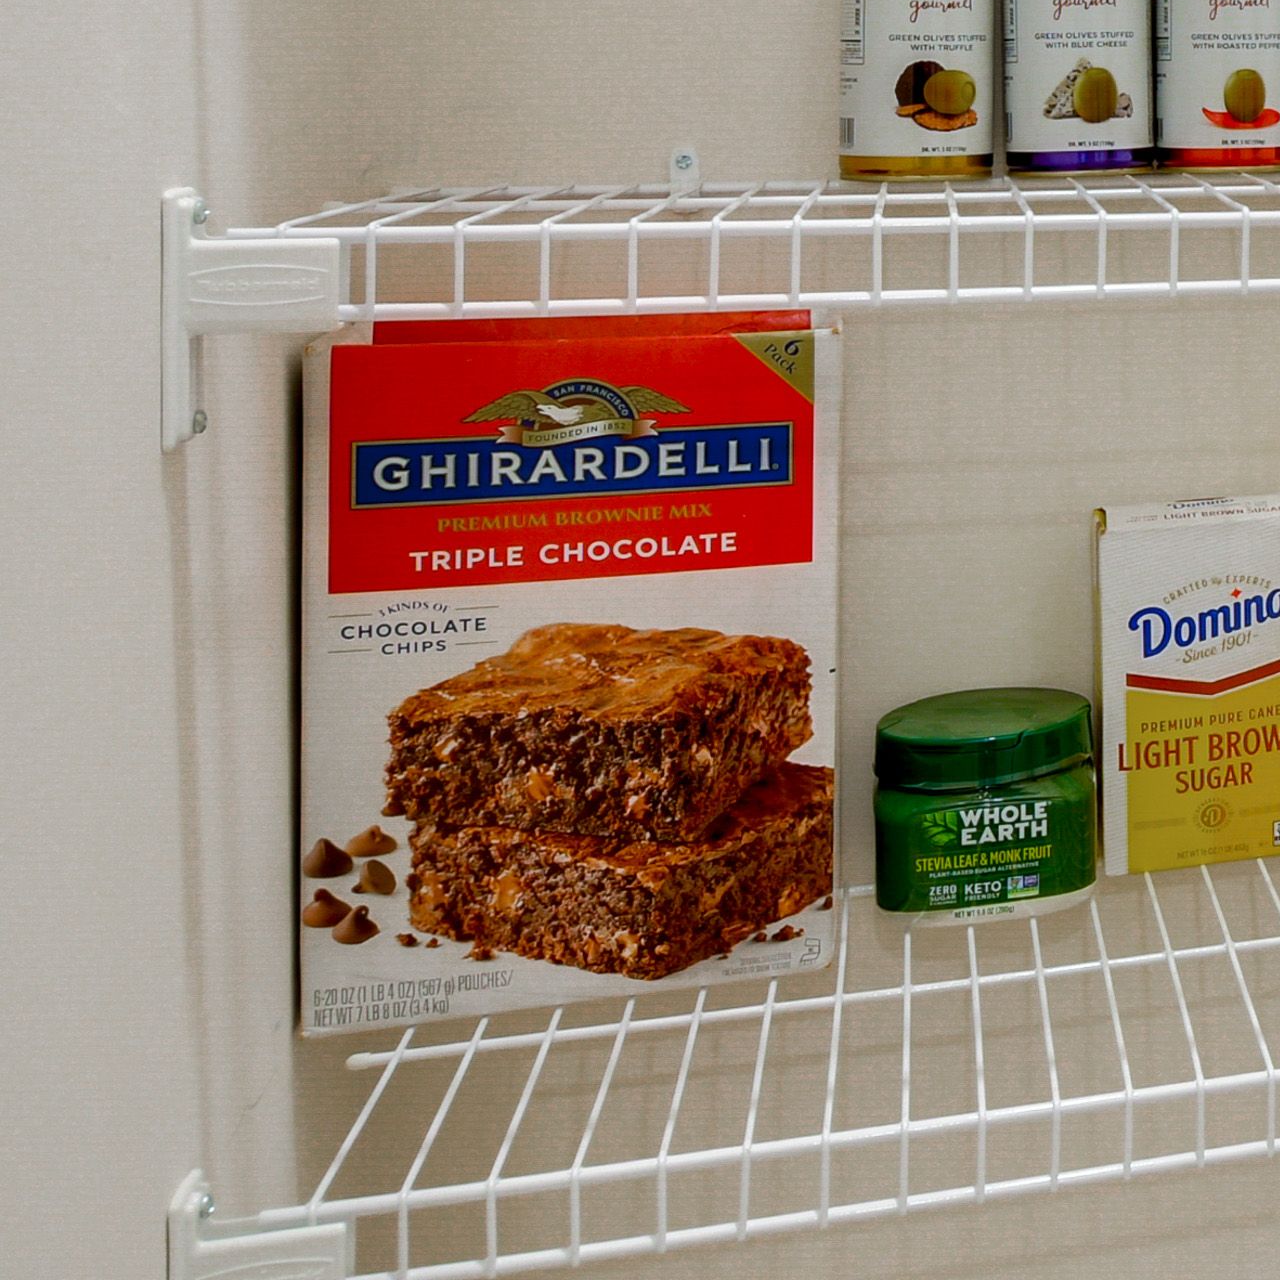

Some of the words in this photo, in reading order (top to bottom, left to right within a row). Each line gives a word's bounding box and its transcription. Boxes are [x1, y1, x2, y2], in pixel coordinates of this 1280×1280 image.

[1100, 31, 1134, 39] STUFFED
[763, 342, 797, 375] Pack
[784, 338, 804, 357] 6
[553, 384, 576, 398] SAN
[580, 383, 630, 417] FRANCISCO
[527, 428, 583, 443] FOUNDED
[585, 425, 599, 434] IN
[603, 422, 626, 432] 1852
[372, 436, 772, 492] GHIRARDELLI
[437, 511, 549, 534] PREMIUM
[554, 505, 664, 528] BROWNIE
[668, 502, 713, 520] MIX
[1163, 511, 1197, 521] LIGHT
[1201, 509, 1244, 519] BROWN
[408, 544, 525, 572] TRIPLE
[538, 531, 738, 566] CHOCOLATE
[1162, 580, 1208, 605] CRAFTED
[1225, 575, 1272, 589] EXPERTS
[377, 607, 386, 618] 3
[387, 600, 430, 615] KINDS
[432, 601, 450, 614] OF
[339, 616, 488, 641] CHOCOLATE
[380, 638, 448, 656] CHIPS
[1141, 717, 1204, 734] PREMIUM
[1209, 710, 1243, 726] PURE
[1118, 736, 1199, 772] LIGHT
[1175, 762, 1254, 794] SUGAR
[960, 801, 1048, 827] WHOLE
[961, 819, 1048, 846] EARTH
[915, 857, 952, 872] STEVIA
[954, 853, 979, 868] LEAF
[980, 853, 987, 866] &
[990, 848, 1021, 865] MONK
[1023, 844, 1052, 860] FRUIT
[929, 884, 957, 896] ZERO
[964, 893, 1000, 901] FRIENDLY
[965, 881, 1002, 895] KETO
[313, 989, 338, 1007] 6-20
[341, 987, 355, 1005] OZ
[357, 985, 367, 1004] (1
[371, 984, 385, 1002] LB
[387, 983, 394, 1000] 4
[399, 981, 415, 999] OZ)
[418, 978, 441, 997] (567
[444, 980, 456, 996] g)
[457, 970, 514, 992] POUCHES/
[313, 1007, 333, 1027] NET
[336, 1006, 353, 1025] WT
[356, 1005, 363, 1023] 7
[366, 1003, 380, 1022] LB
[382, 1002, 390, 1019] 8
[392, 1001, 407, 1018] OZ
[409, 999, 429, 1018] (3.4
[432, 997, 450, 1015] kg)
